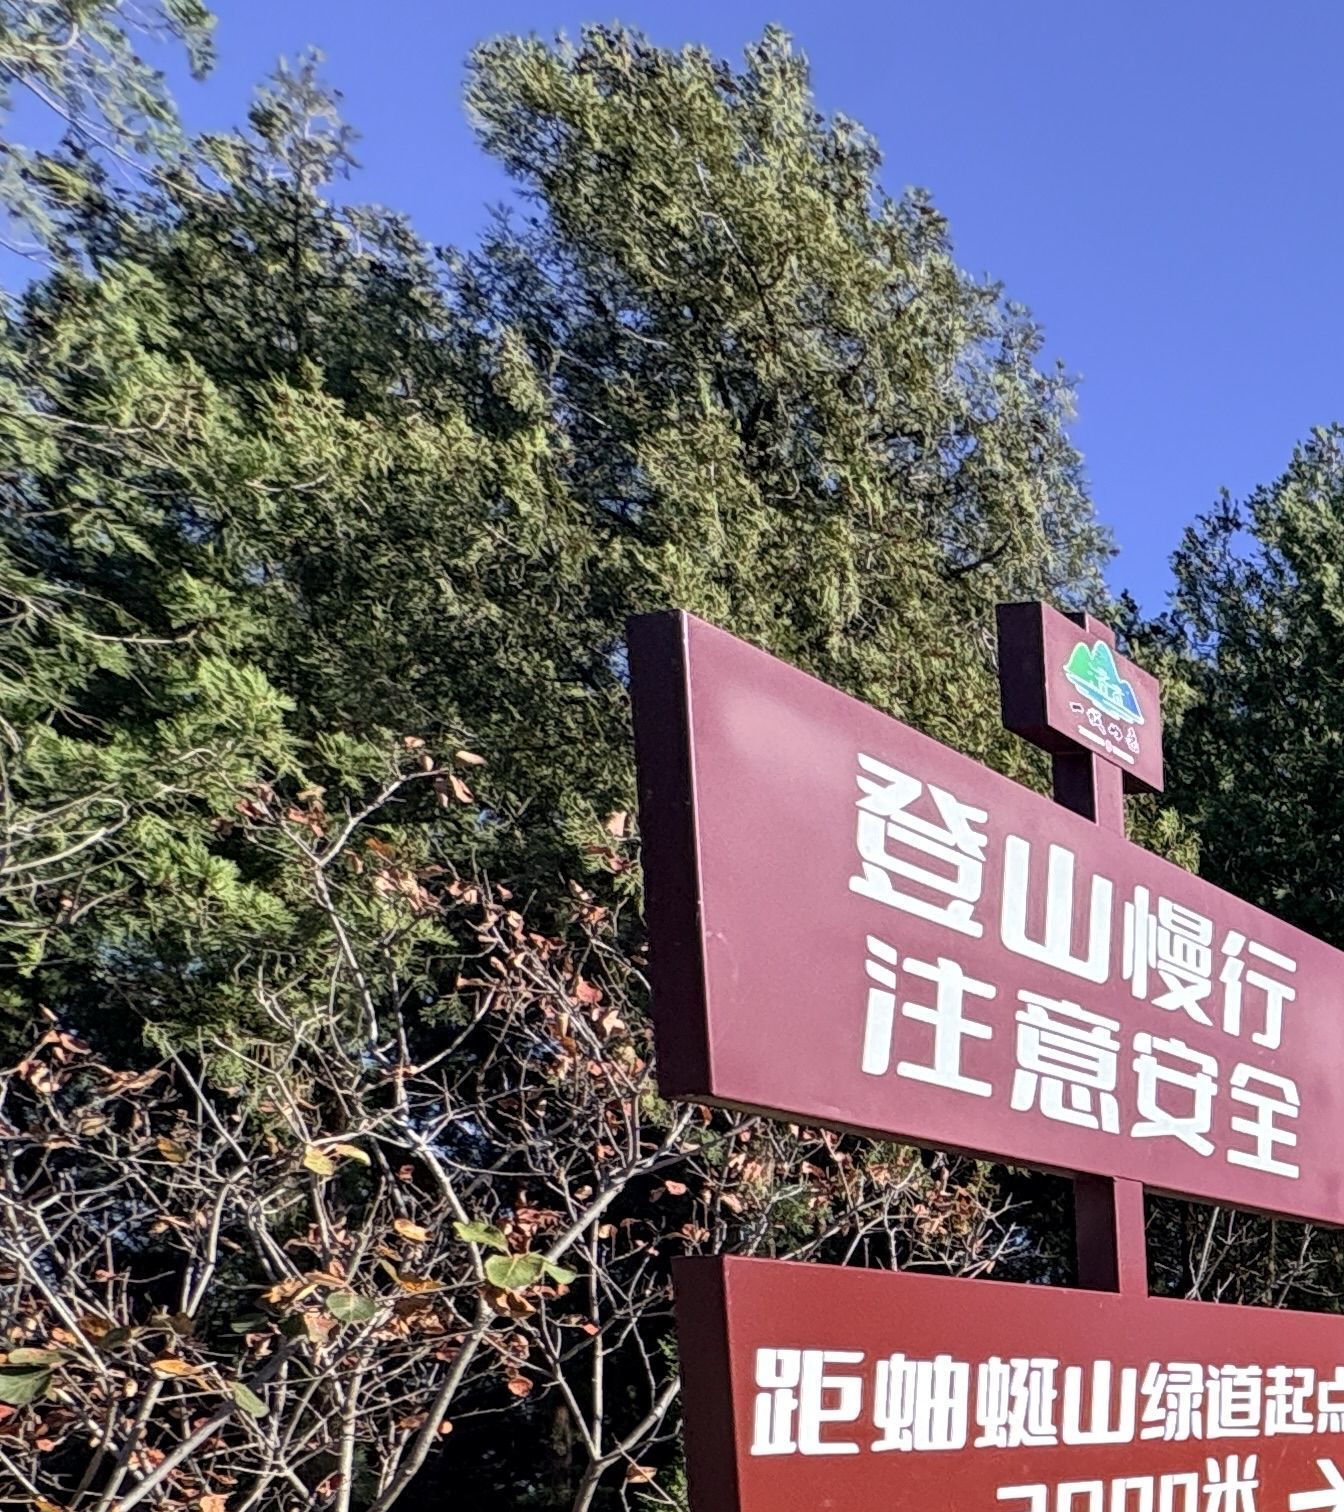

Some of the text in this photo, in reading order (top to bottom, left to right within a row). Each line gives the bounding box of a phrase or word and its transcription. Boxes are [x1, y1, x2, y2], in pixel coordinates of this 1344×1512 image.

[848, 752, 1297, 1051] 登山慢行
[861, 936, 1302, 1180] 注意安全
